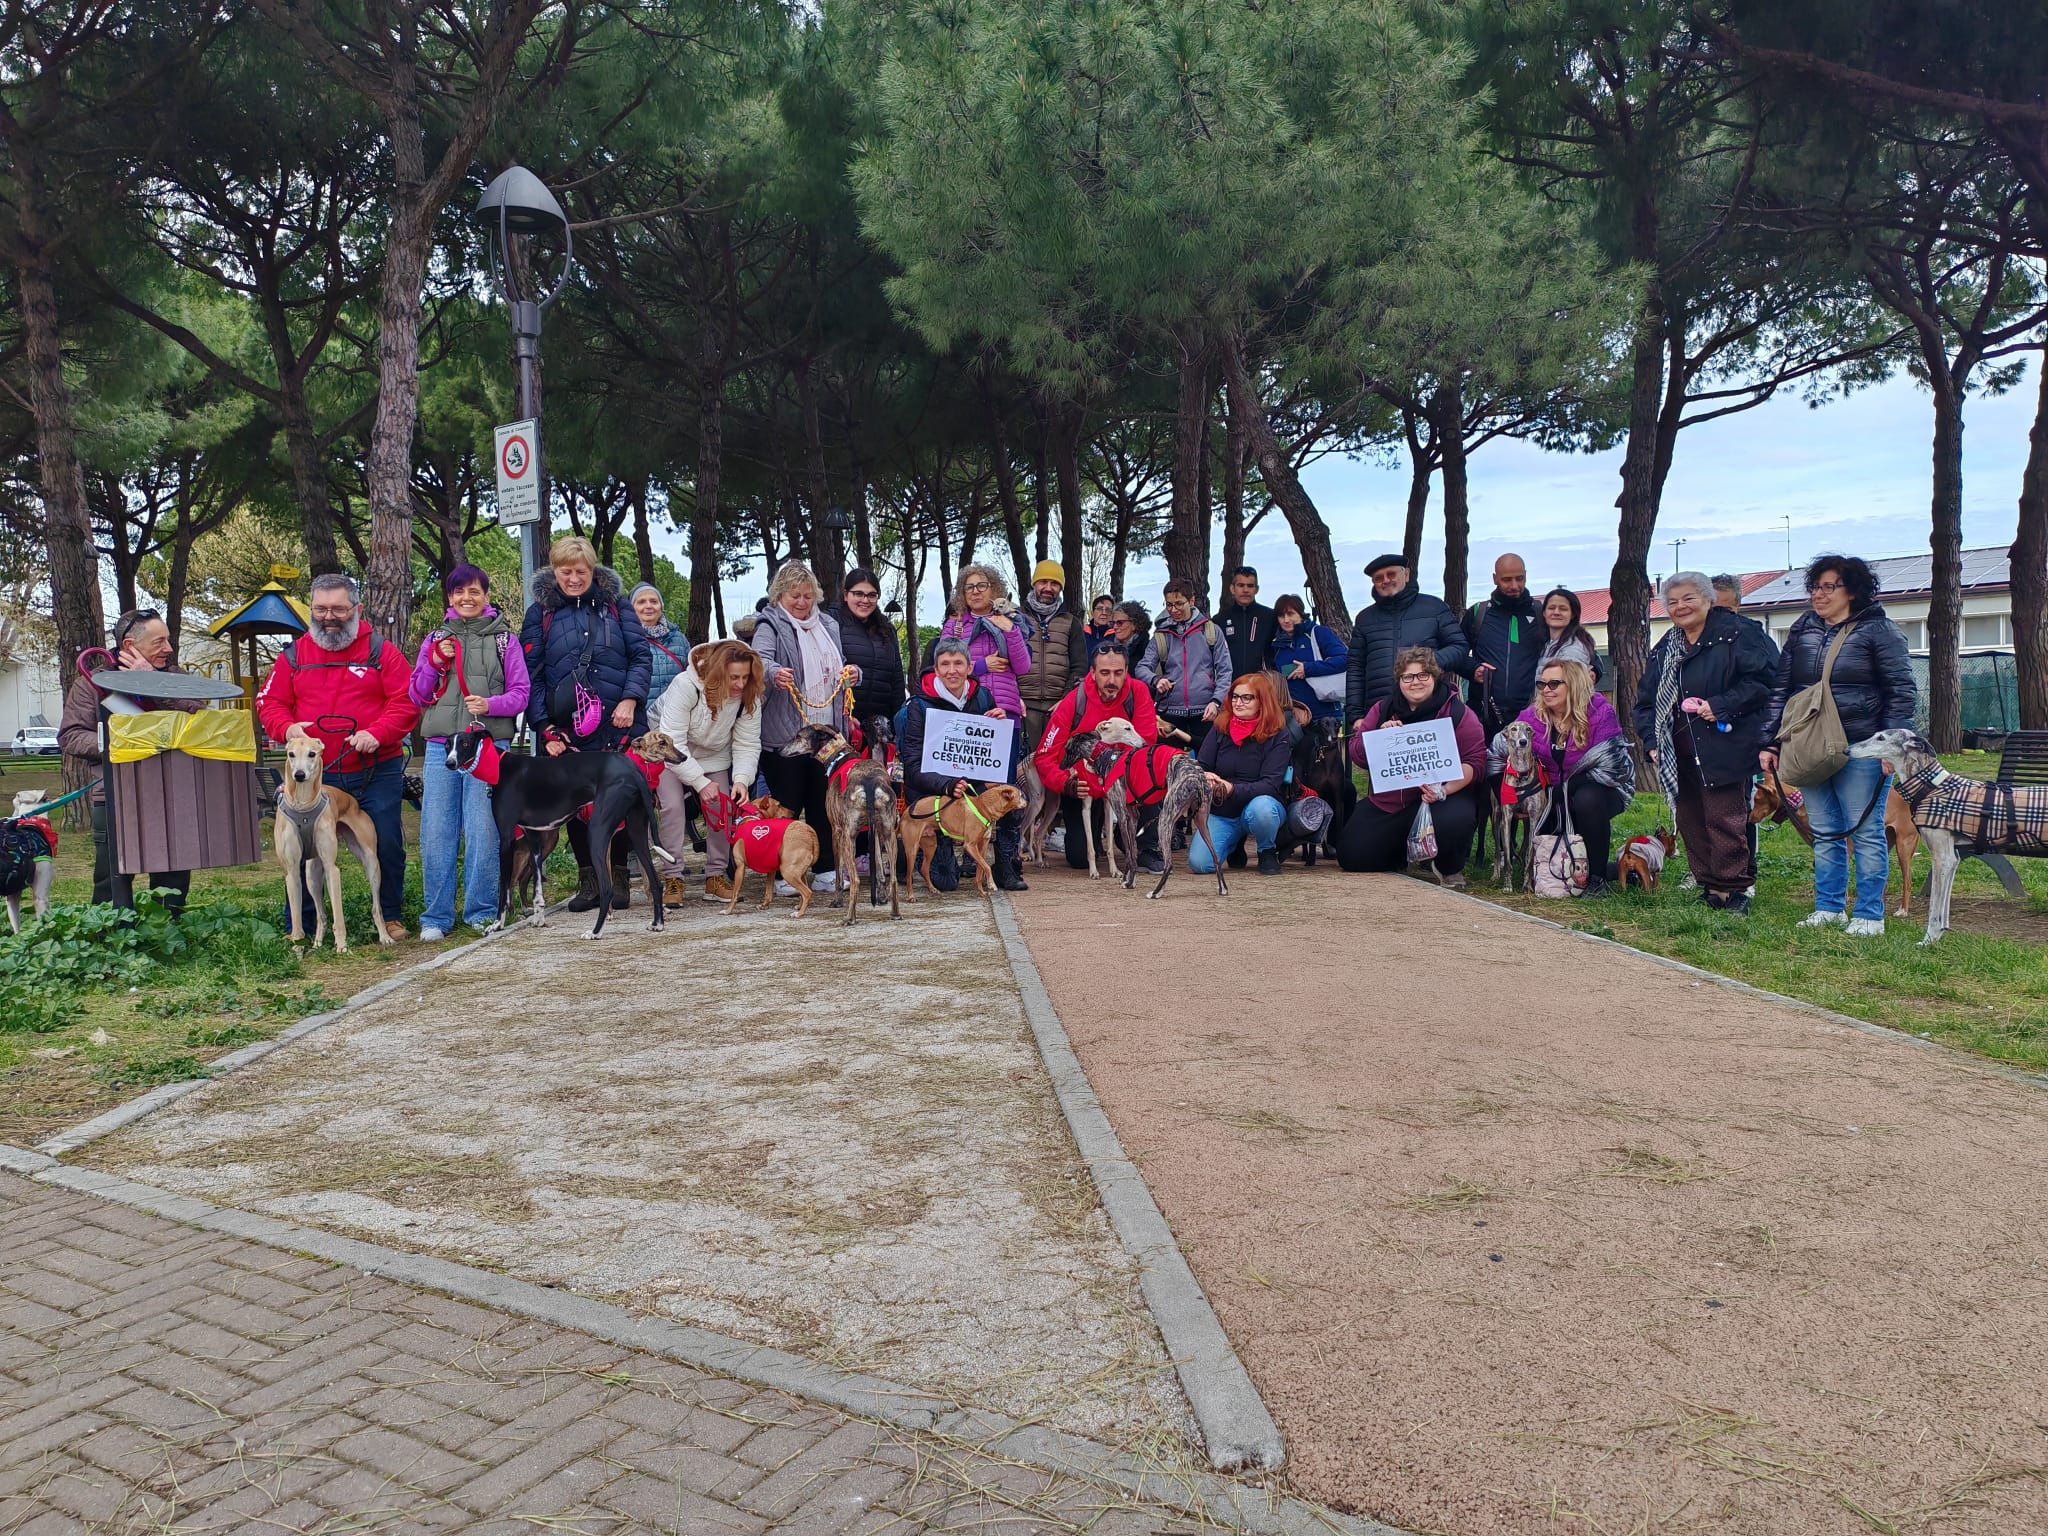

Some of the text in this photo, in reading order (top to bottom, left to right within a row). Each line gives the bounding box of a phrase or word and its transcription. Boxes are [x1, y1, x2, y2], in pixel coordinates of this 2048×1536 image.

[965, 726, 995, 739] GACI
[1406, 732, 1437, 745] GACI
[944, 735, 981, 747] Passeggiata
[943, 742, 992, 758] LEVRIERI
[1387, 746, 1427, 757] Passeggiata
[932, 751, 1002, 769] CESENATICO
[1388, 750, 1440, 767] LEVRIERI
[1380, 758, 1453, 778] CESENATICO
